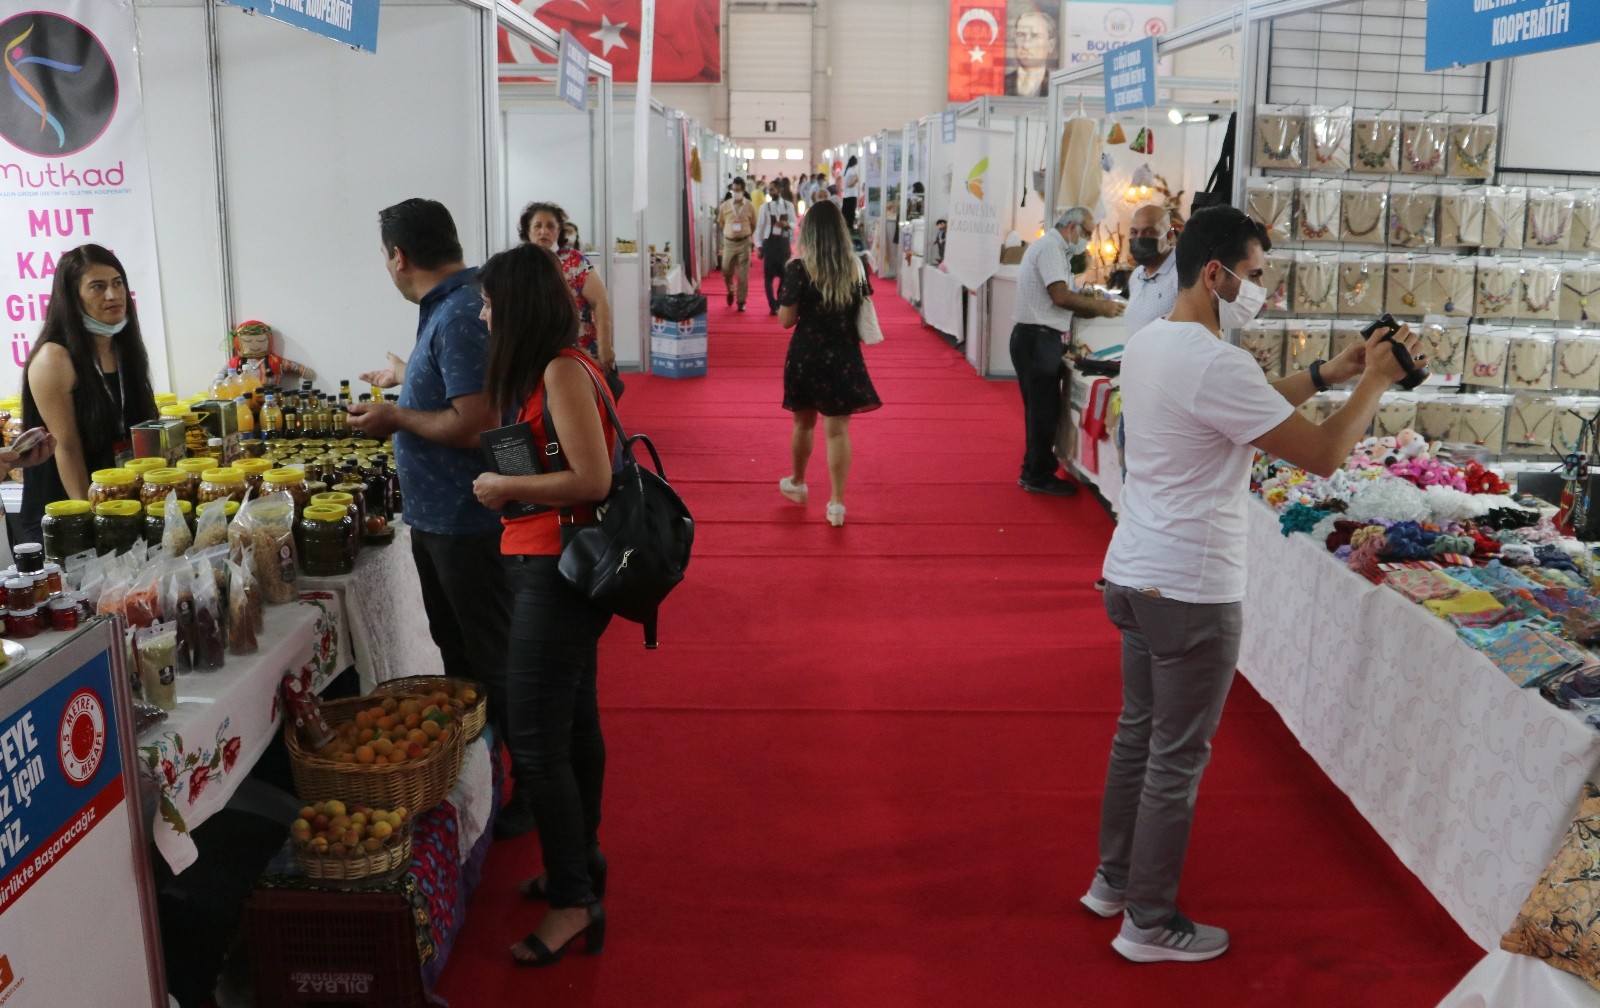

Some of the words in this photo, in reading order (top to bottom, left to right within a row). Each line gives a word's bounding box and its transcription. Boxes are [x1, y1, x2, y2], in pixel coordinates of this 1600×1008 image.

[28, 208, 94, 237] MUT
[66, 697, 91, 727] METRE
[81, 731, 102, 777] MESAFE
[34, 806, 96, 873] Başaracağız
